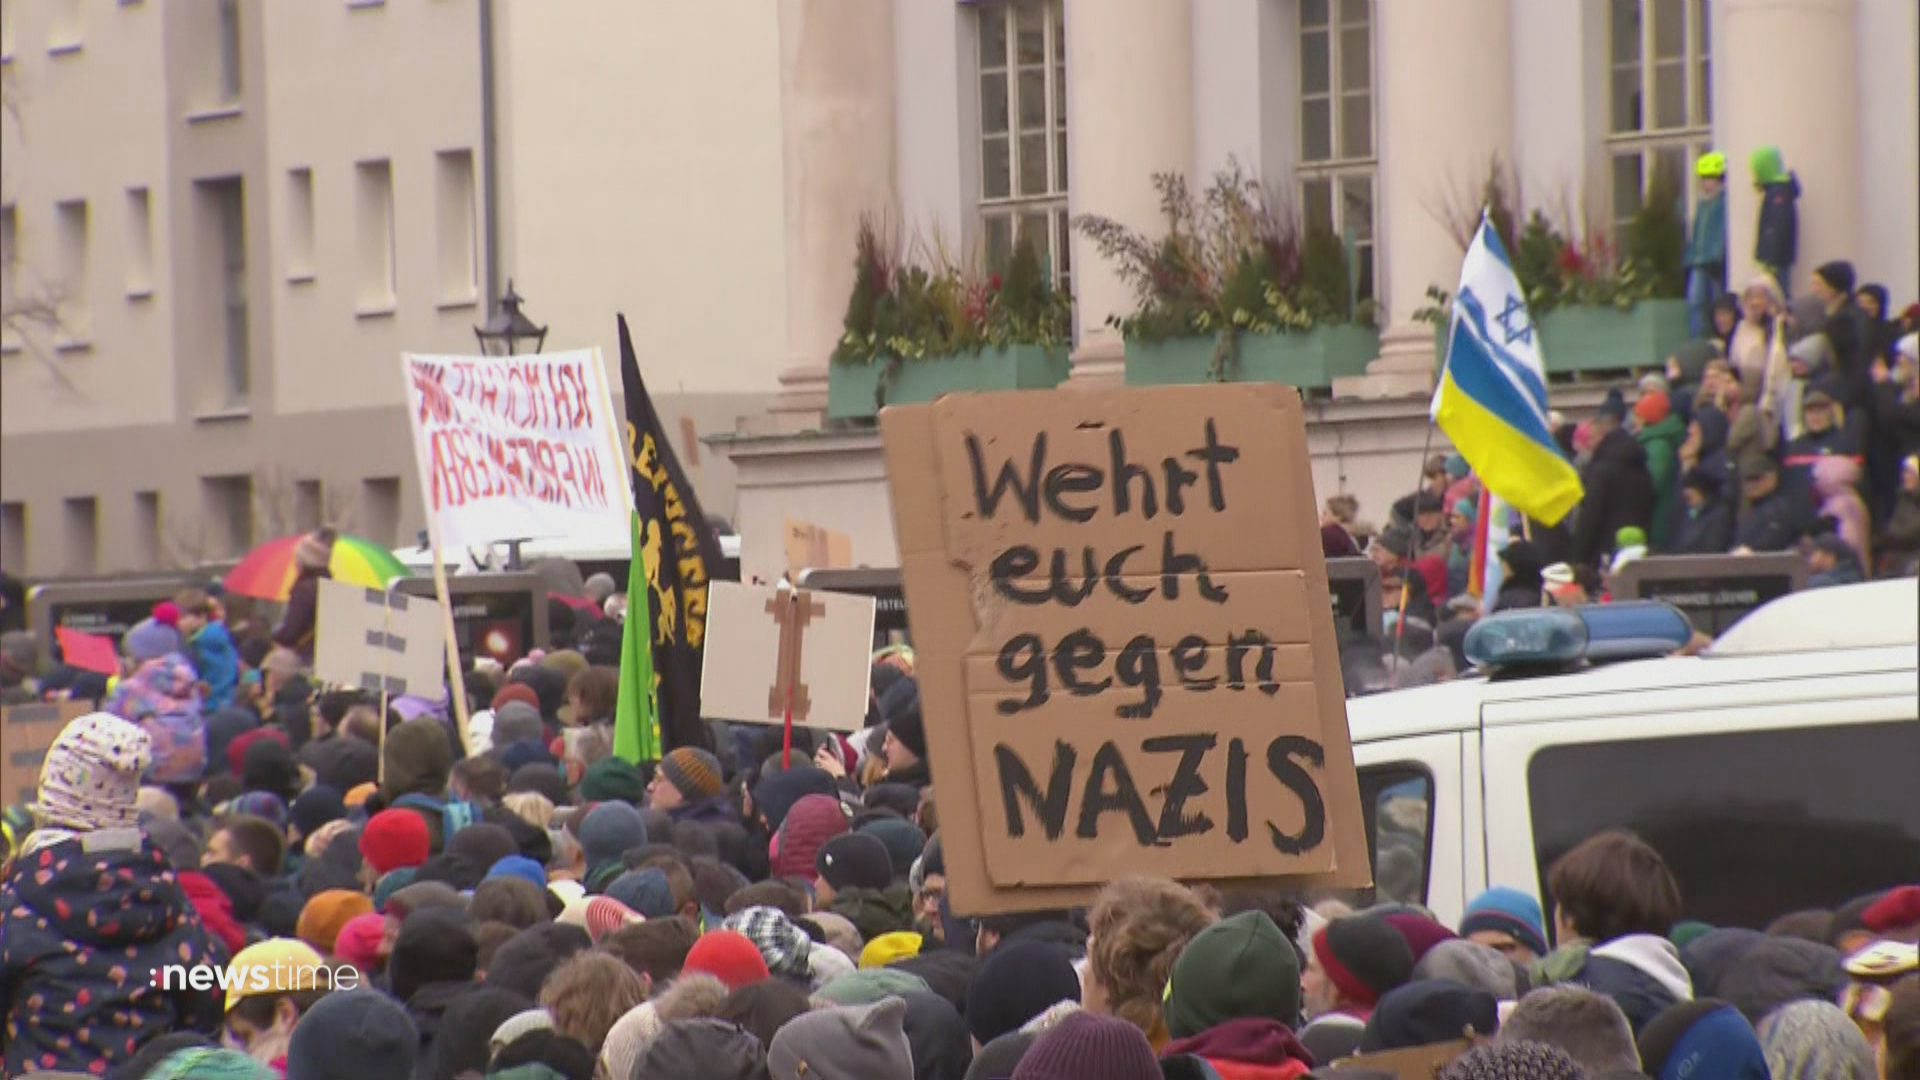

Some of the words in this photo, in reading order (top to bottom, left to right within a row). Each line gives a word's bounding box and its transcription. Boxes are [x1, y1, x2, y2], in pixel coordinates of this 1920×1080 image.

[964, 416, 1240, 525] Wehrt
[989, 530, 1230, 607] euch
[996, 627, 1281, 719] gegen
[992, 732, 1326, 857] NAZIS
